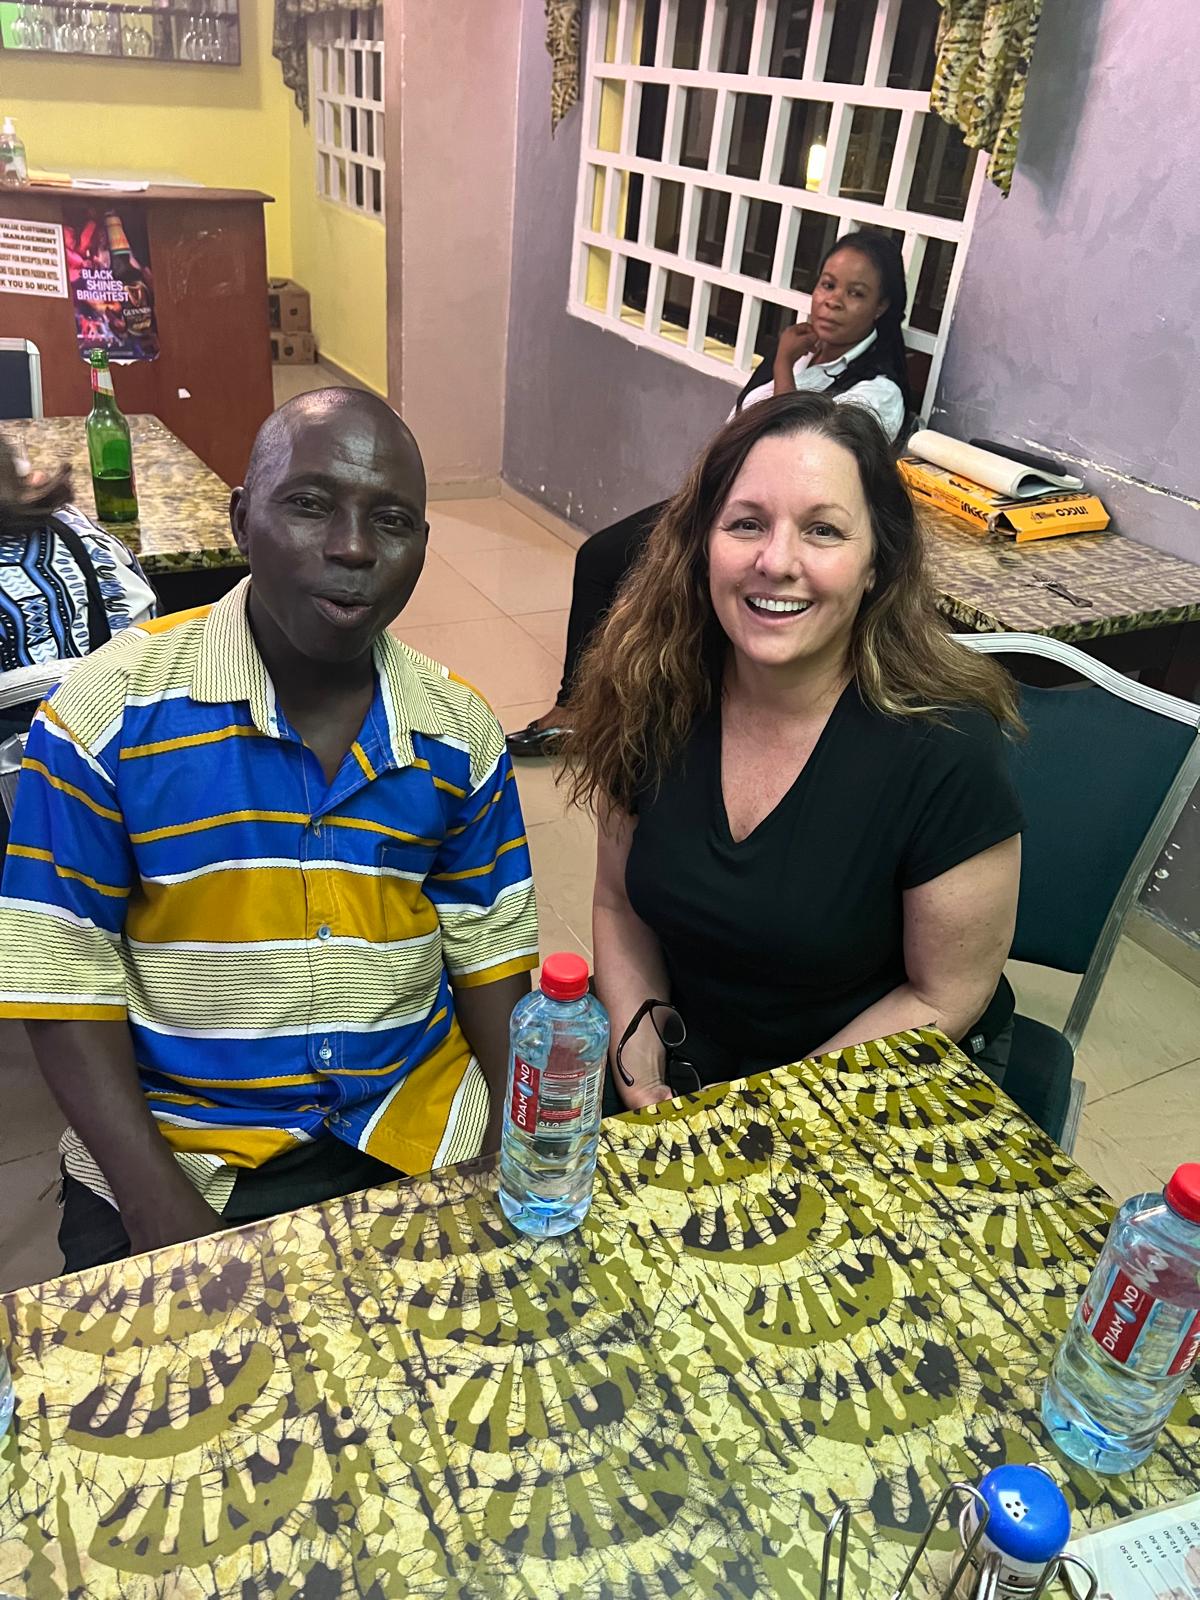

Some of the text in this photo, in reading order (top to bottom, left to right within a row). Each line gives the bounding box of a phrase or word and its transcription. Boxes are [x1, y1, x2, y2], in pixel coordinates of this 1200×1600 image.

[3, 232, 57, 244] MANAGEMENT
[81, 268, 114, 281] BLACK
[8, 280, 24, 288] YOU
[25, 281, 35, 290] SO
[86, 280, 124, 292] SHINES
[76, 289, 129, 302] BRIGHTEST
[1163, 1530, 1182, 1554] $12.50
[1119, 1545, 1138, 1569] $10.50
[1134, 1540, 1153, 1564] $12.50
